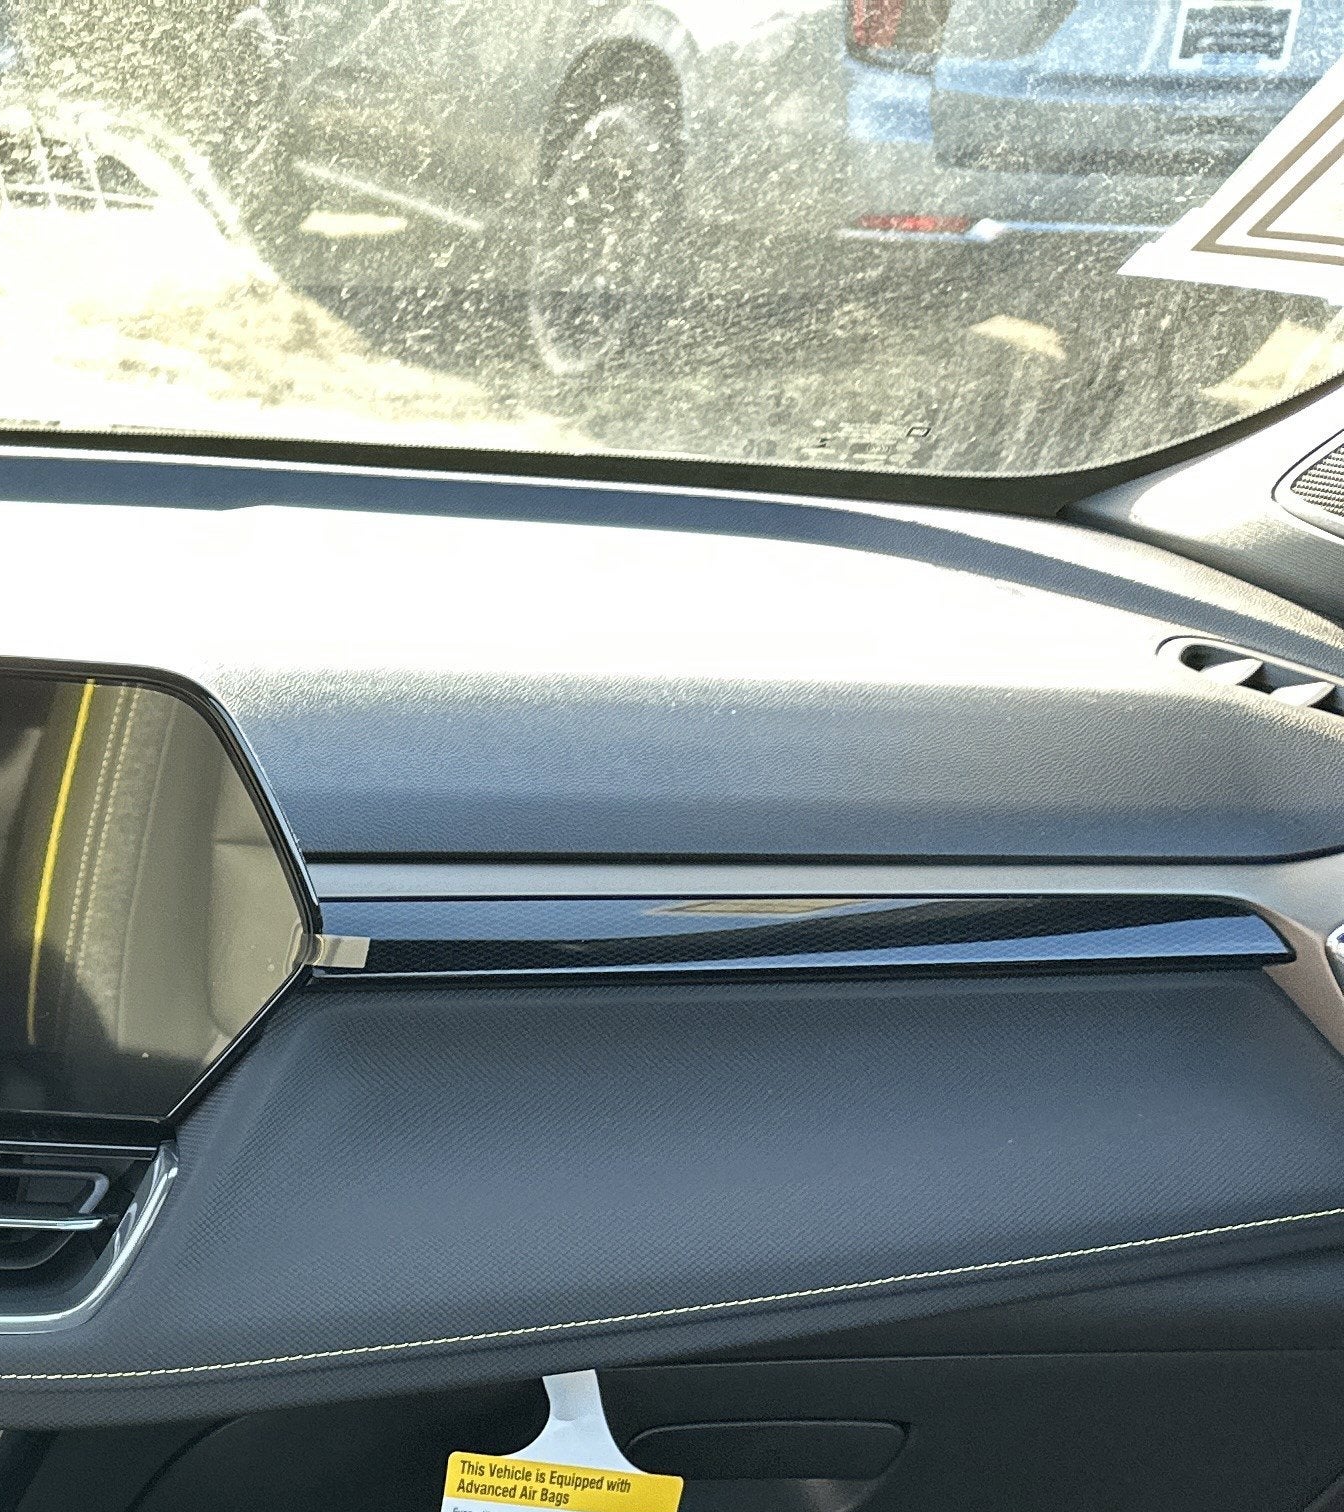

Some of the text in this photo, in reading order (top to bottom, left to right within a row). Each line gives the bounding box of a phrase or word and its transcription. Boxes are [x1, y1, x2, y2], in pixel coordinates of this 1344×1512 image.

[460, 1460, 631, 1493] This Vehicle is Equipped with
[457, 1478, 570, 1507] Advanced Air Bags
